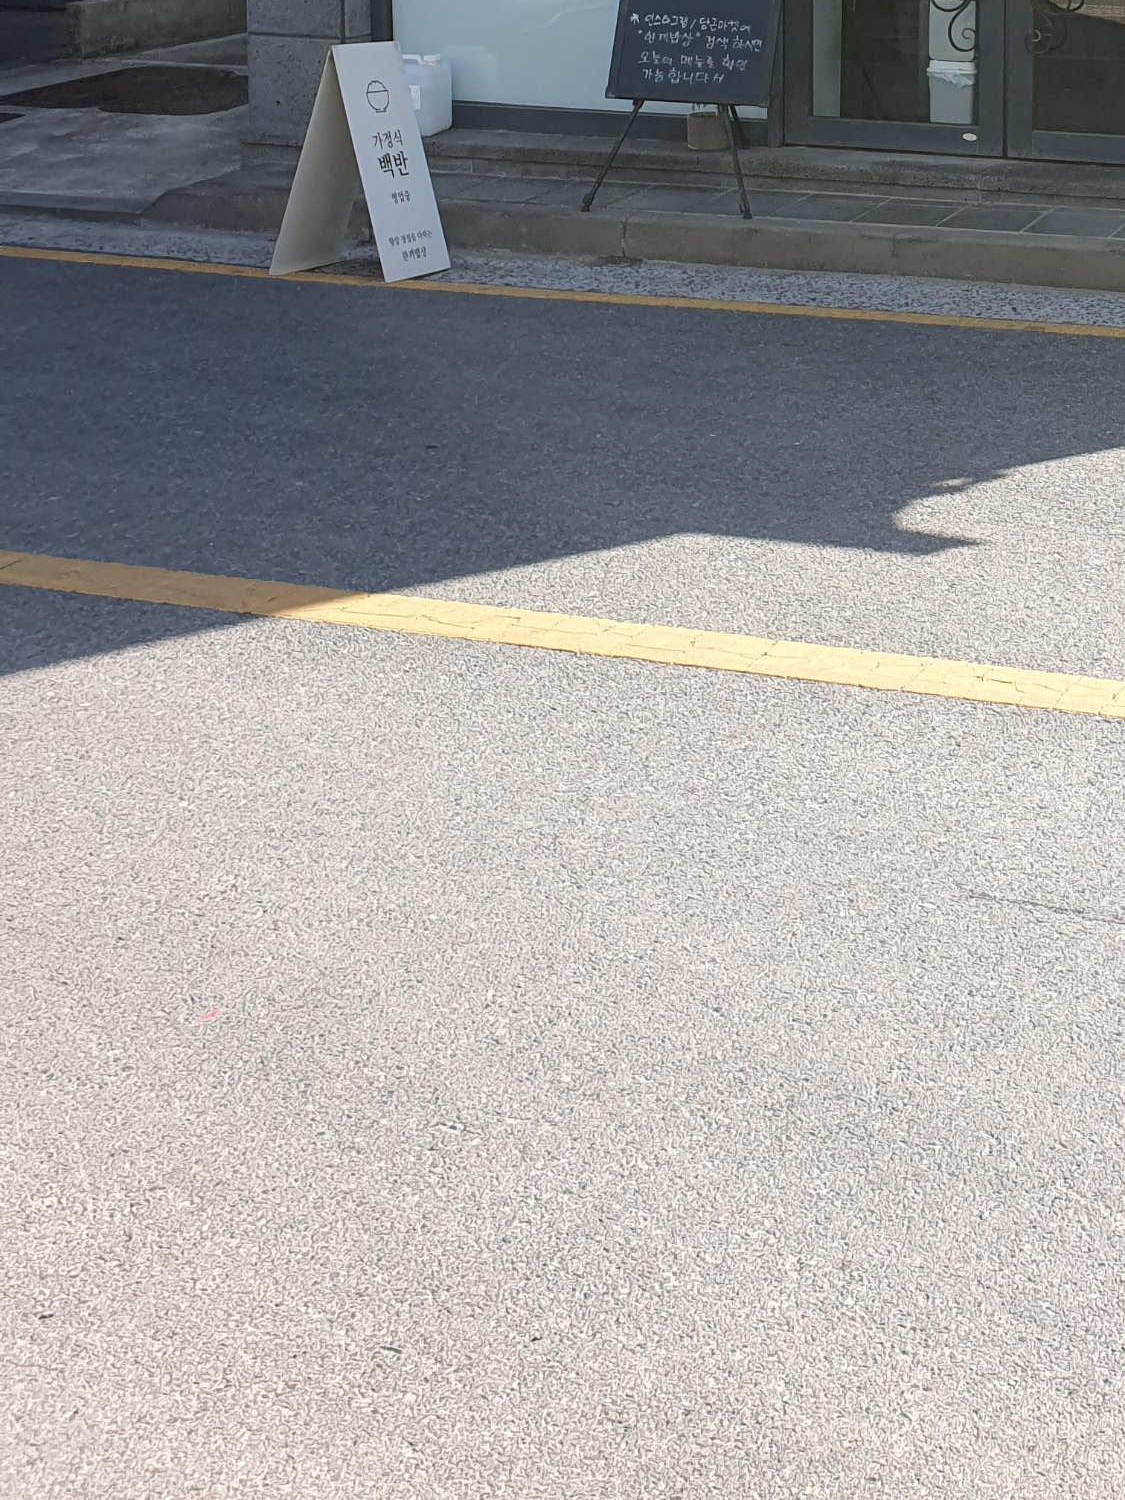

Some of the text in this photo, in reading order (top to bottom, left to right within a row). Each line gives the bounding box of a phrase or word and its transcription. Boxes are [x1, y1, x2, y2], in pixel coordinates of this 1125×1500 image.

[638, 50, 673, 66] 오늘의
[371, 129, 405, 151] 가정식
[377, 150, 410, 179] 백반
[391, 190, 412, 204] 영업중
